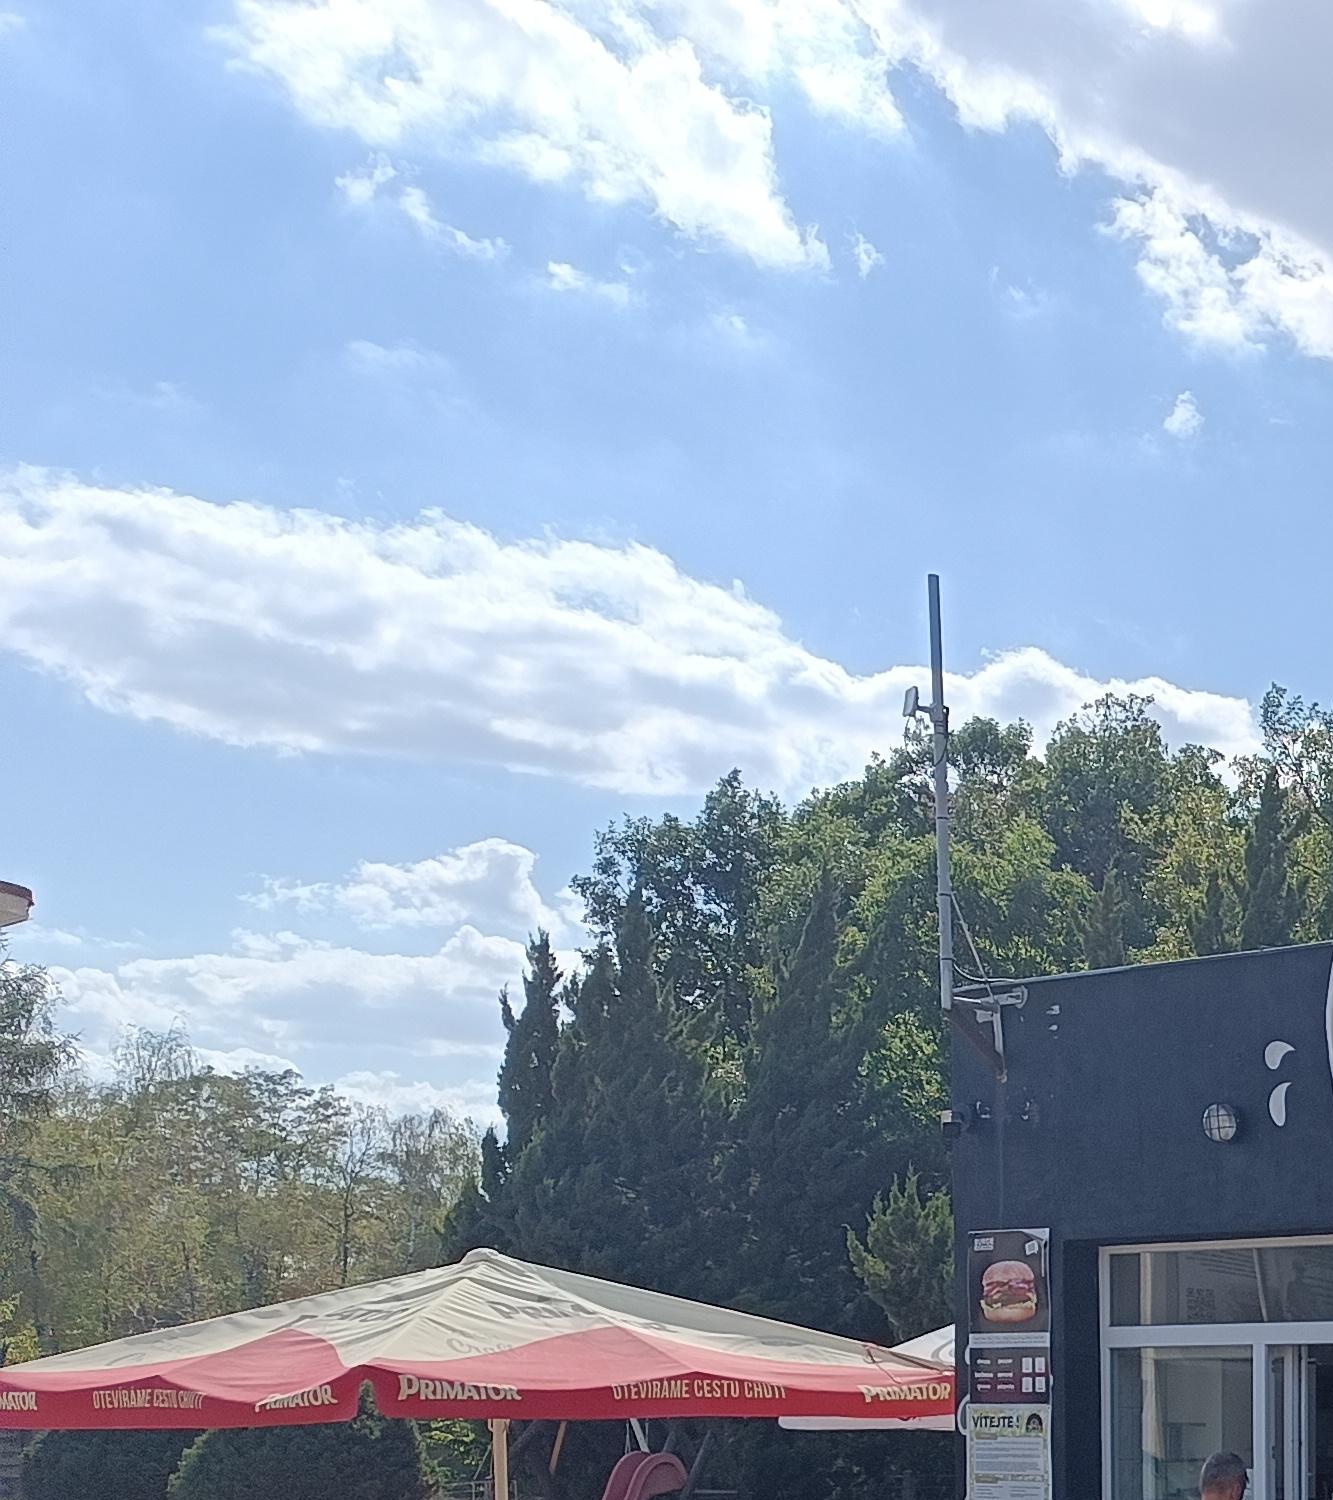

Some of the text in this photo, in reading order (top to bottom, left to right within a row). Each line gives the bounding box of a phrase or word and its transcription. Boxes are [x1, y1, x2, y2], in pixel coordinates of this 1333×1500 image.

[0, 1391, 38, 1411] MATOR
[93, 1385, 151, 1409] OTEVÍRÁME
[153, 1388, 178, 1409] CESTU
[398, 1374, 522, 1401] PRIMATOR
[694, 1379, 739, 1399] CESTU
[858, 1382, 951, 1403] PRIMATOR
